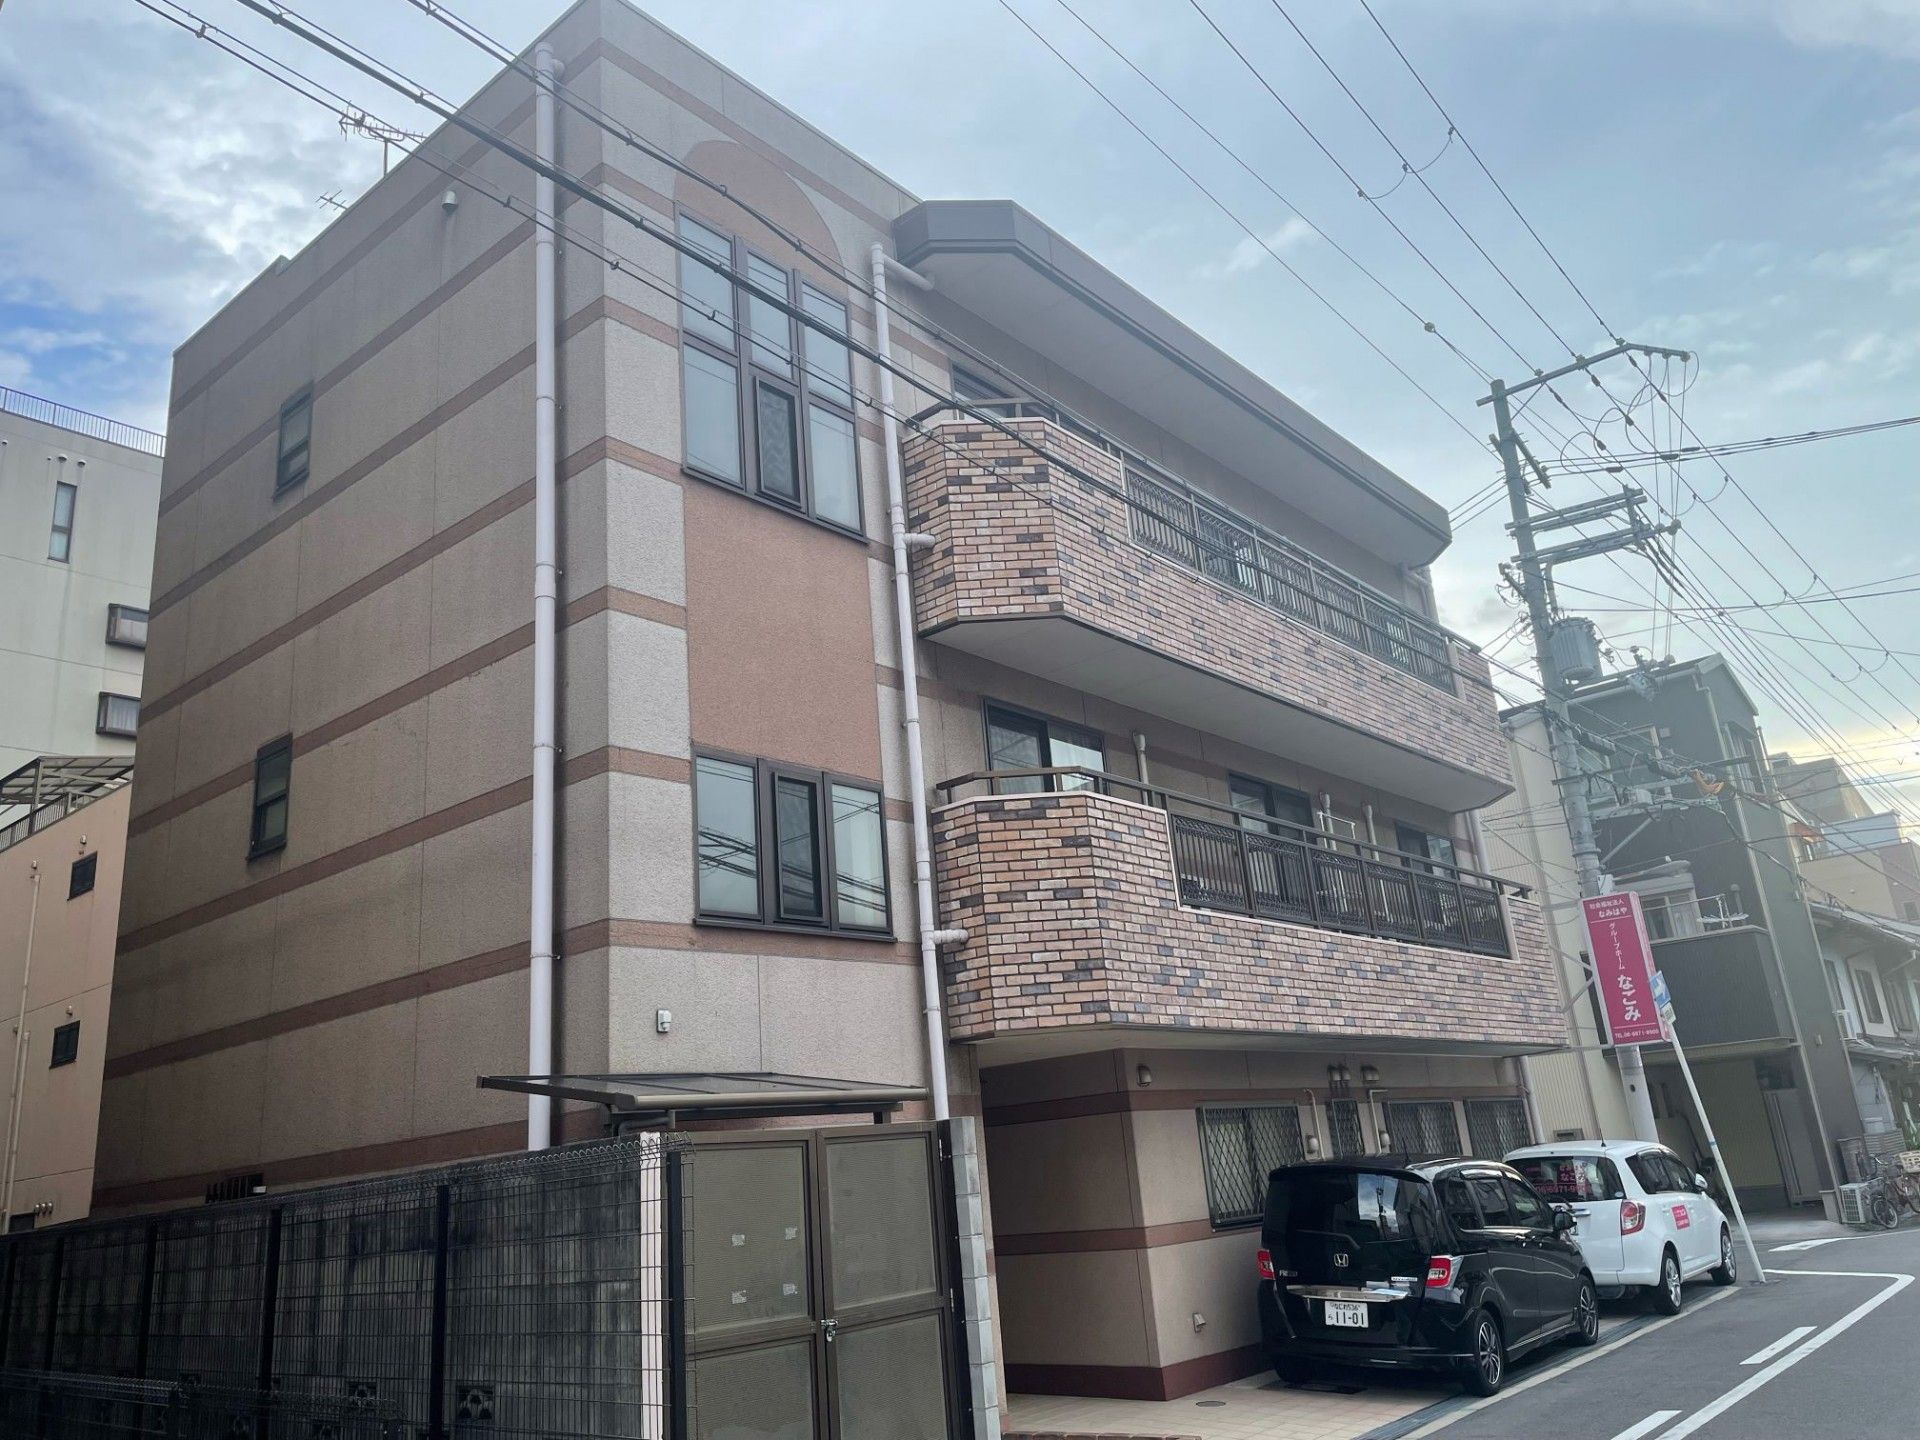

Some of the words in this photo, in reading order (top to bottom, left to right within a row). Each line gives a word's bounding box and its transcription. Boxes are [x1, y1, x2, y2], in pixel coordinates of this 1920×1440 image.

[1609, 922, 1625, 970] グループホーム
[1336, 1311, 1364, 1325] 11-01
